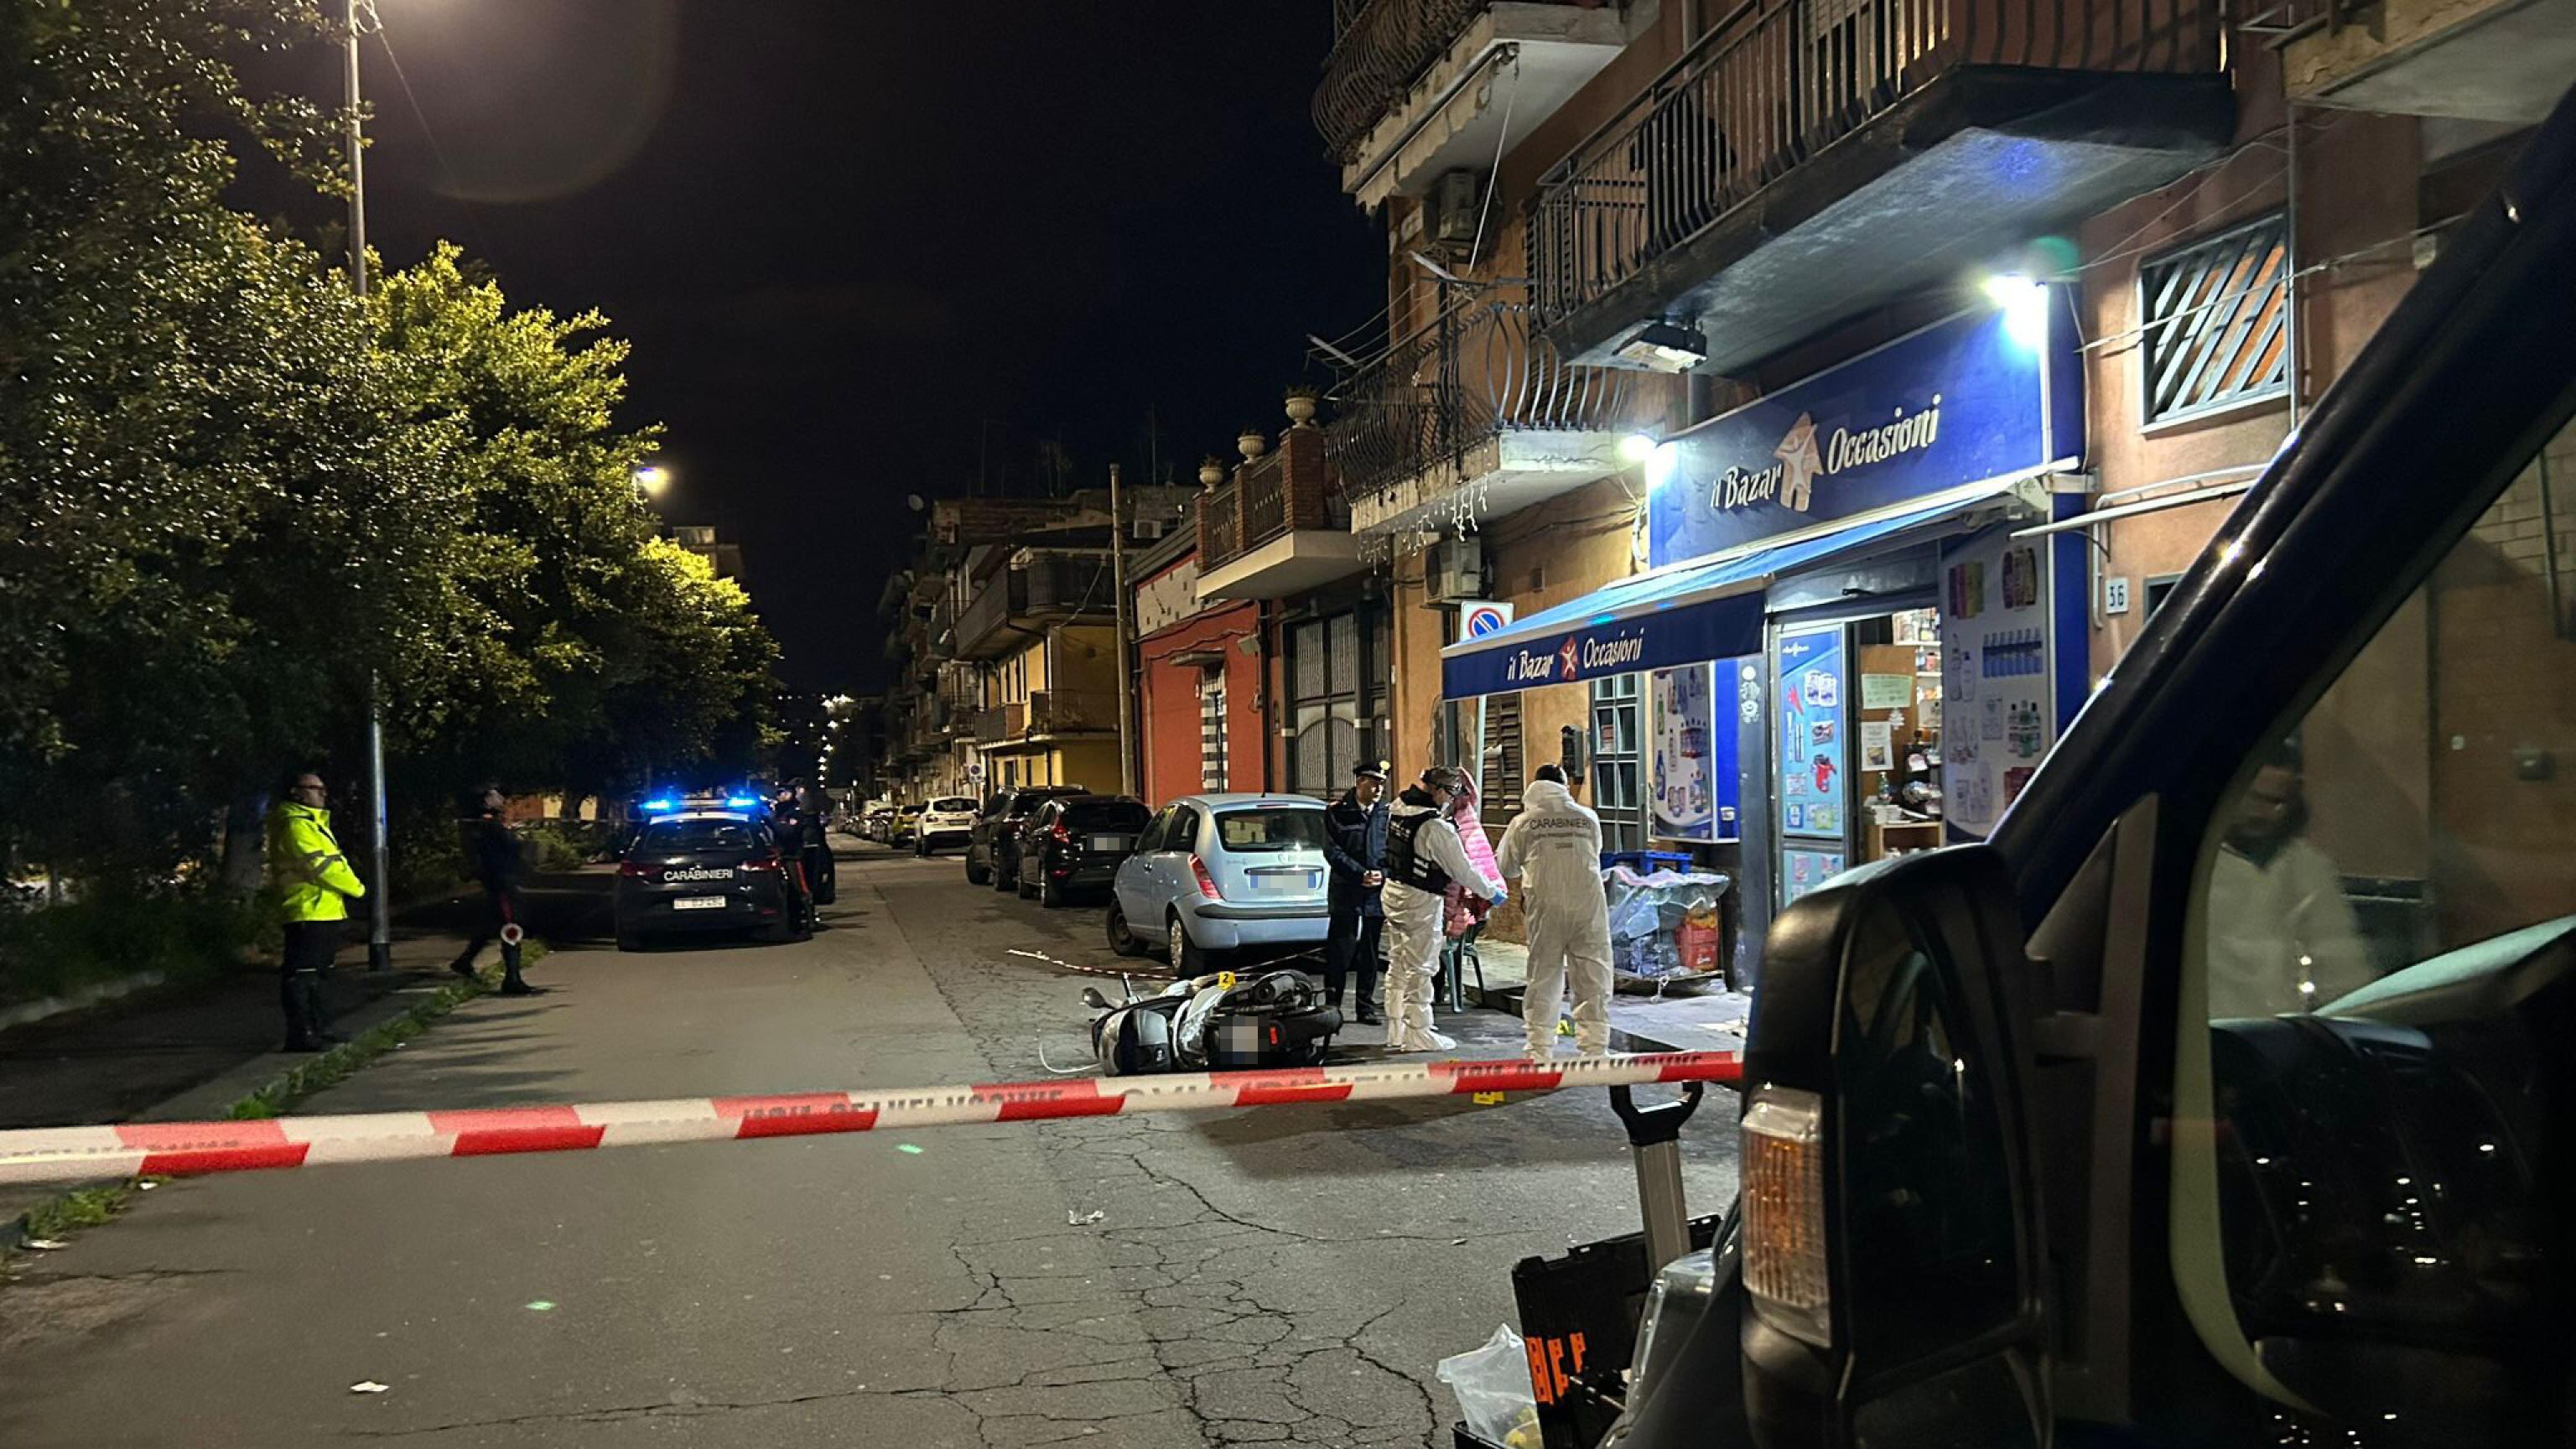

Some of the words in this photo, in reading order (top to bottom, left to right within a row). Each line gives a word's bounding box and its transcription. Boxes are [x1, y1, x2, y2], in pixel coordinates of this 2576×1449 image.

[1724, 463, 1782, 510] Bazar
[1828, 393, 1942, 475] Occasioni
[1519, 650, 1555, 681] Bazar
[1583, 627, 1645, 669] Occasioni
[663, 868, 734, 881] CARABINIERI
